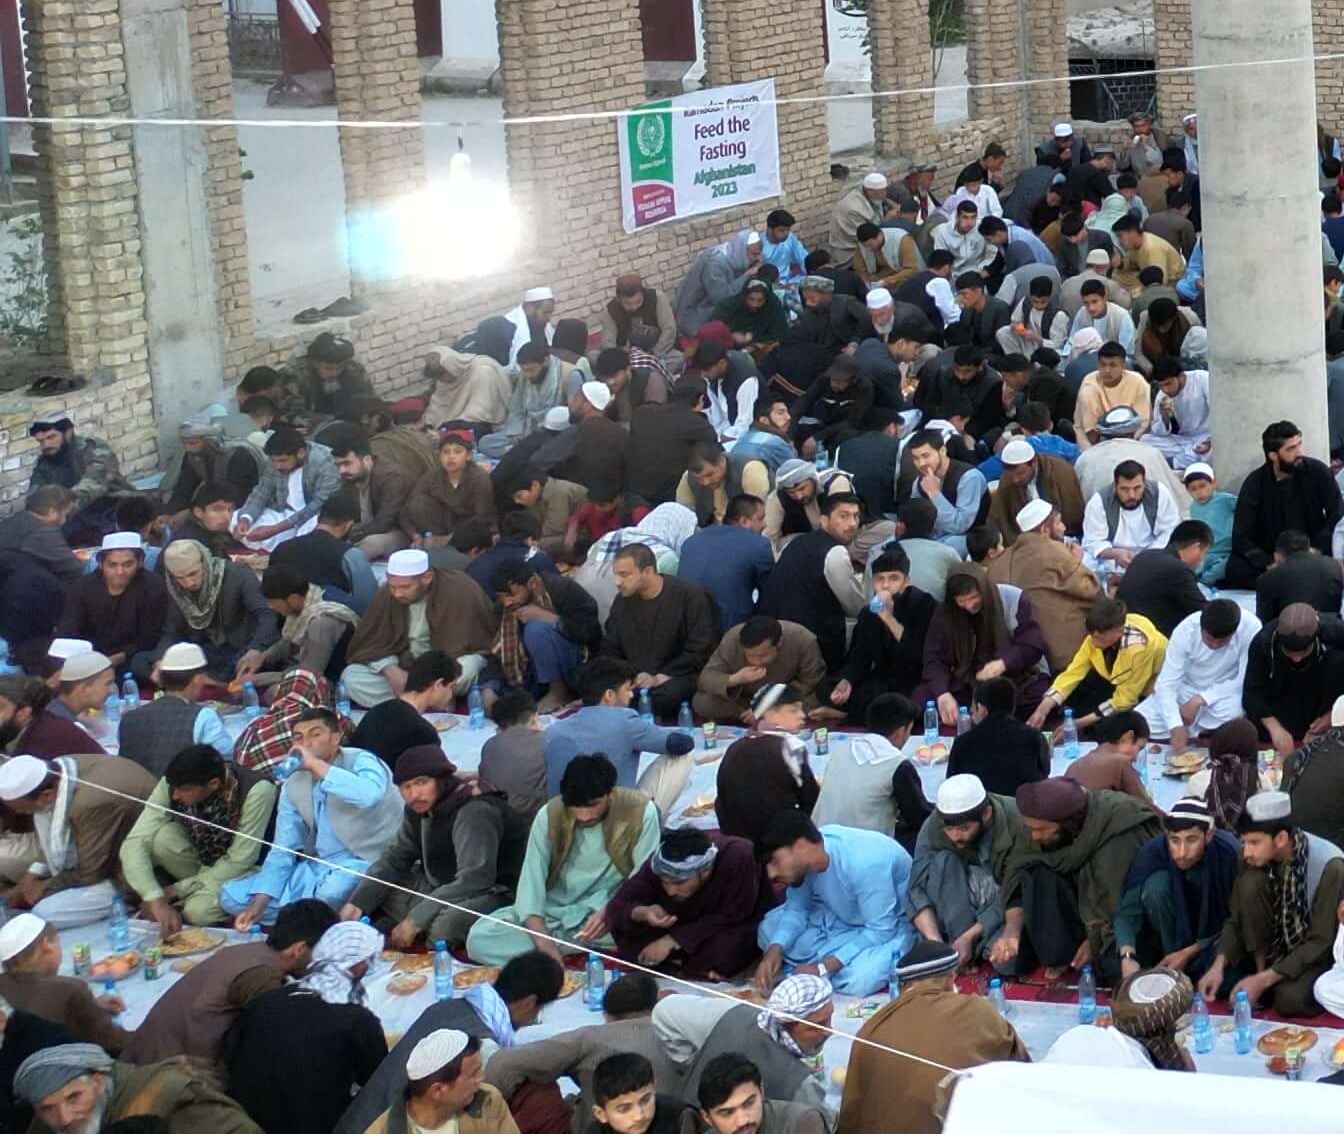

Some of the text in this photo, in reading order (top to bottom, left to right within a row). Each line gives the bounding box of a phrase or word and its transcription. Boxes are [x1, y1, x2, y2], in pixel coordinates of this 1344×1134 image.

[694, 115, 750, 140] Feed the
[700, 139, 746, 162] Fasting
